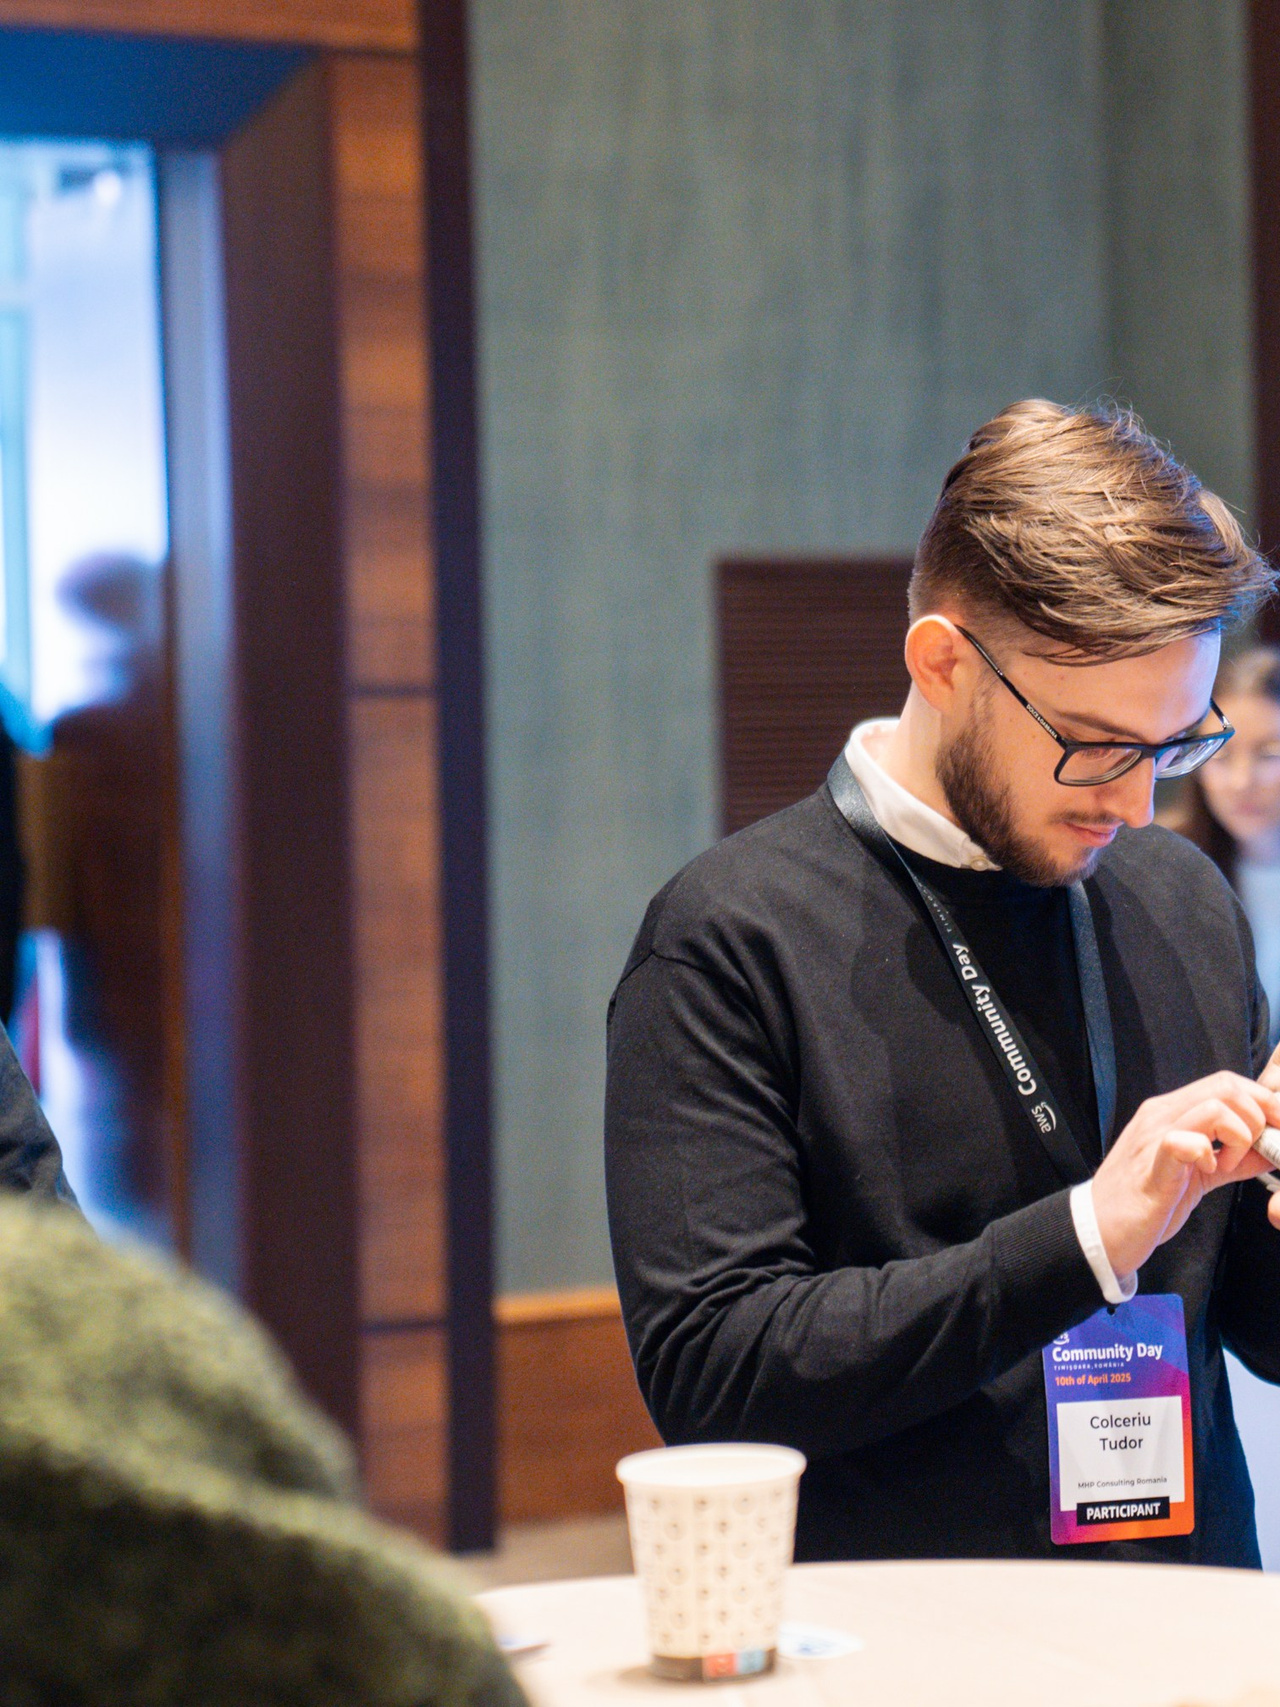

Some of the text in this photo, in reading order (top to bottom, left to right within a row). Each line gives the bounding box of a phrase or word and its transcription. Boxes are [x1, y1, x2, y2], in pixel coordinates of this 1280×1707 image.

[953, 943, 1052, 1134] aws Community Day
[1052, 1342, 1163, 1362] Community Day
[1055, 1372, 1131, 1386] 10th of April 2025
[1090, 1412, 1151, 1429] Colceriu
[1099, 1436, 1143, 1451] Tudor
[1096, 1479, 1135, 1488] Consulting
[1136, 1476, 1167, 1485] Romania
[1086, 1502, 1161, 1520] PARTICIPANT
